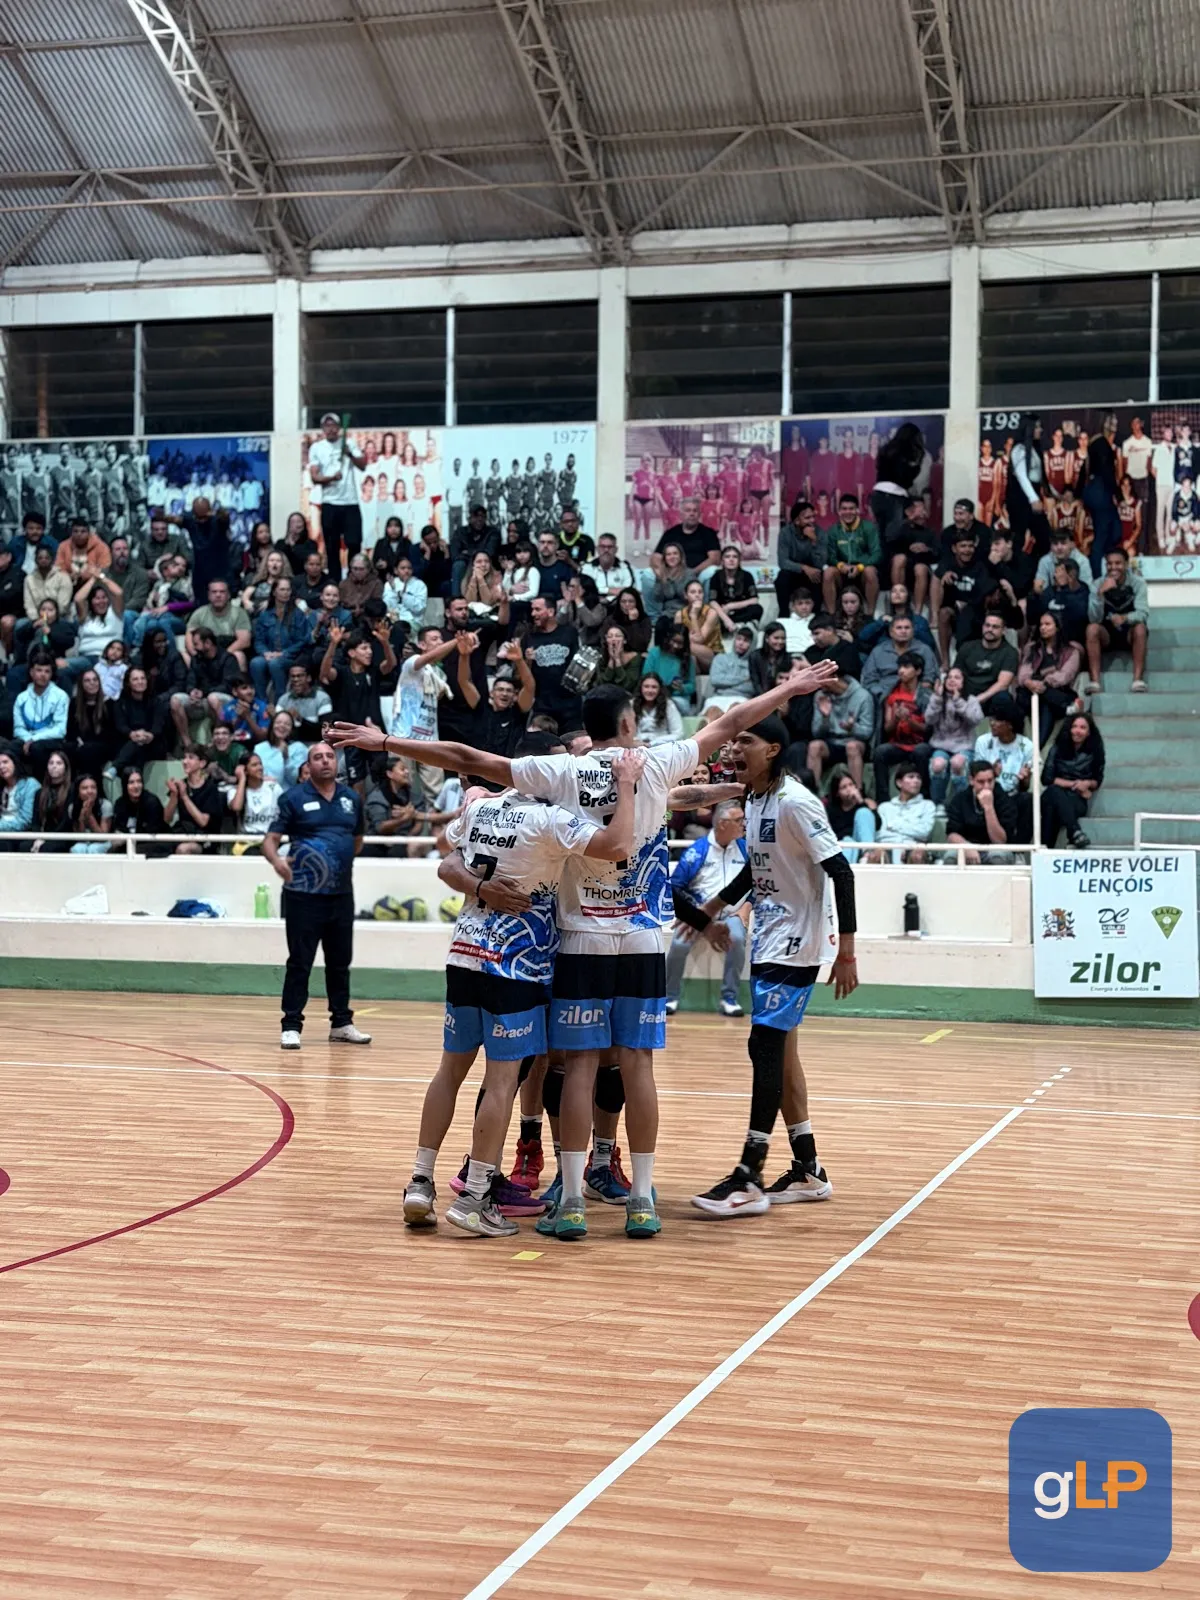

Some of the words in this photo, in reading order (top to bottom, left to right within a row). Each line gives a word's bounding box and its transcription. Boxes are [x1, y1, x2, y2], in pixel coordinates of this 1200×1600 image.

[982, 412, 1021, 430] 198
[553, 430, 588, 444] 1977
[579, 791, 618, 807] Brac
[469, 827, 517, 849] Bracell
[1052, 857, 1122, 874] SEMPRE
[1128, 855, 1179, 872] VÔLEI
[583, 882, 650, 900] THOMRISS
[1079, 875, 1153, 896] LENÇÓIS
[786, 937, 801, 956] 13
